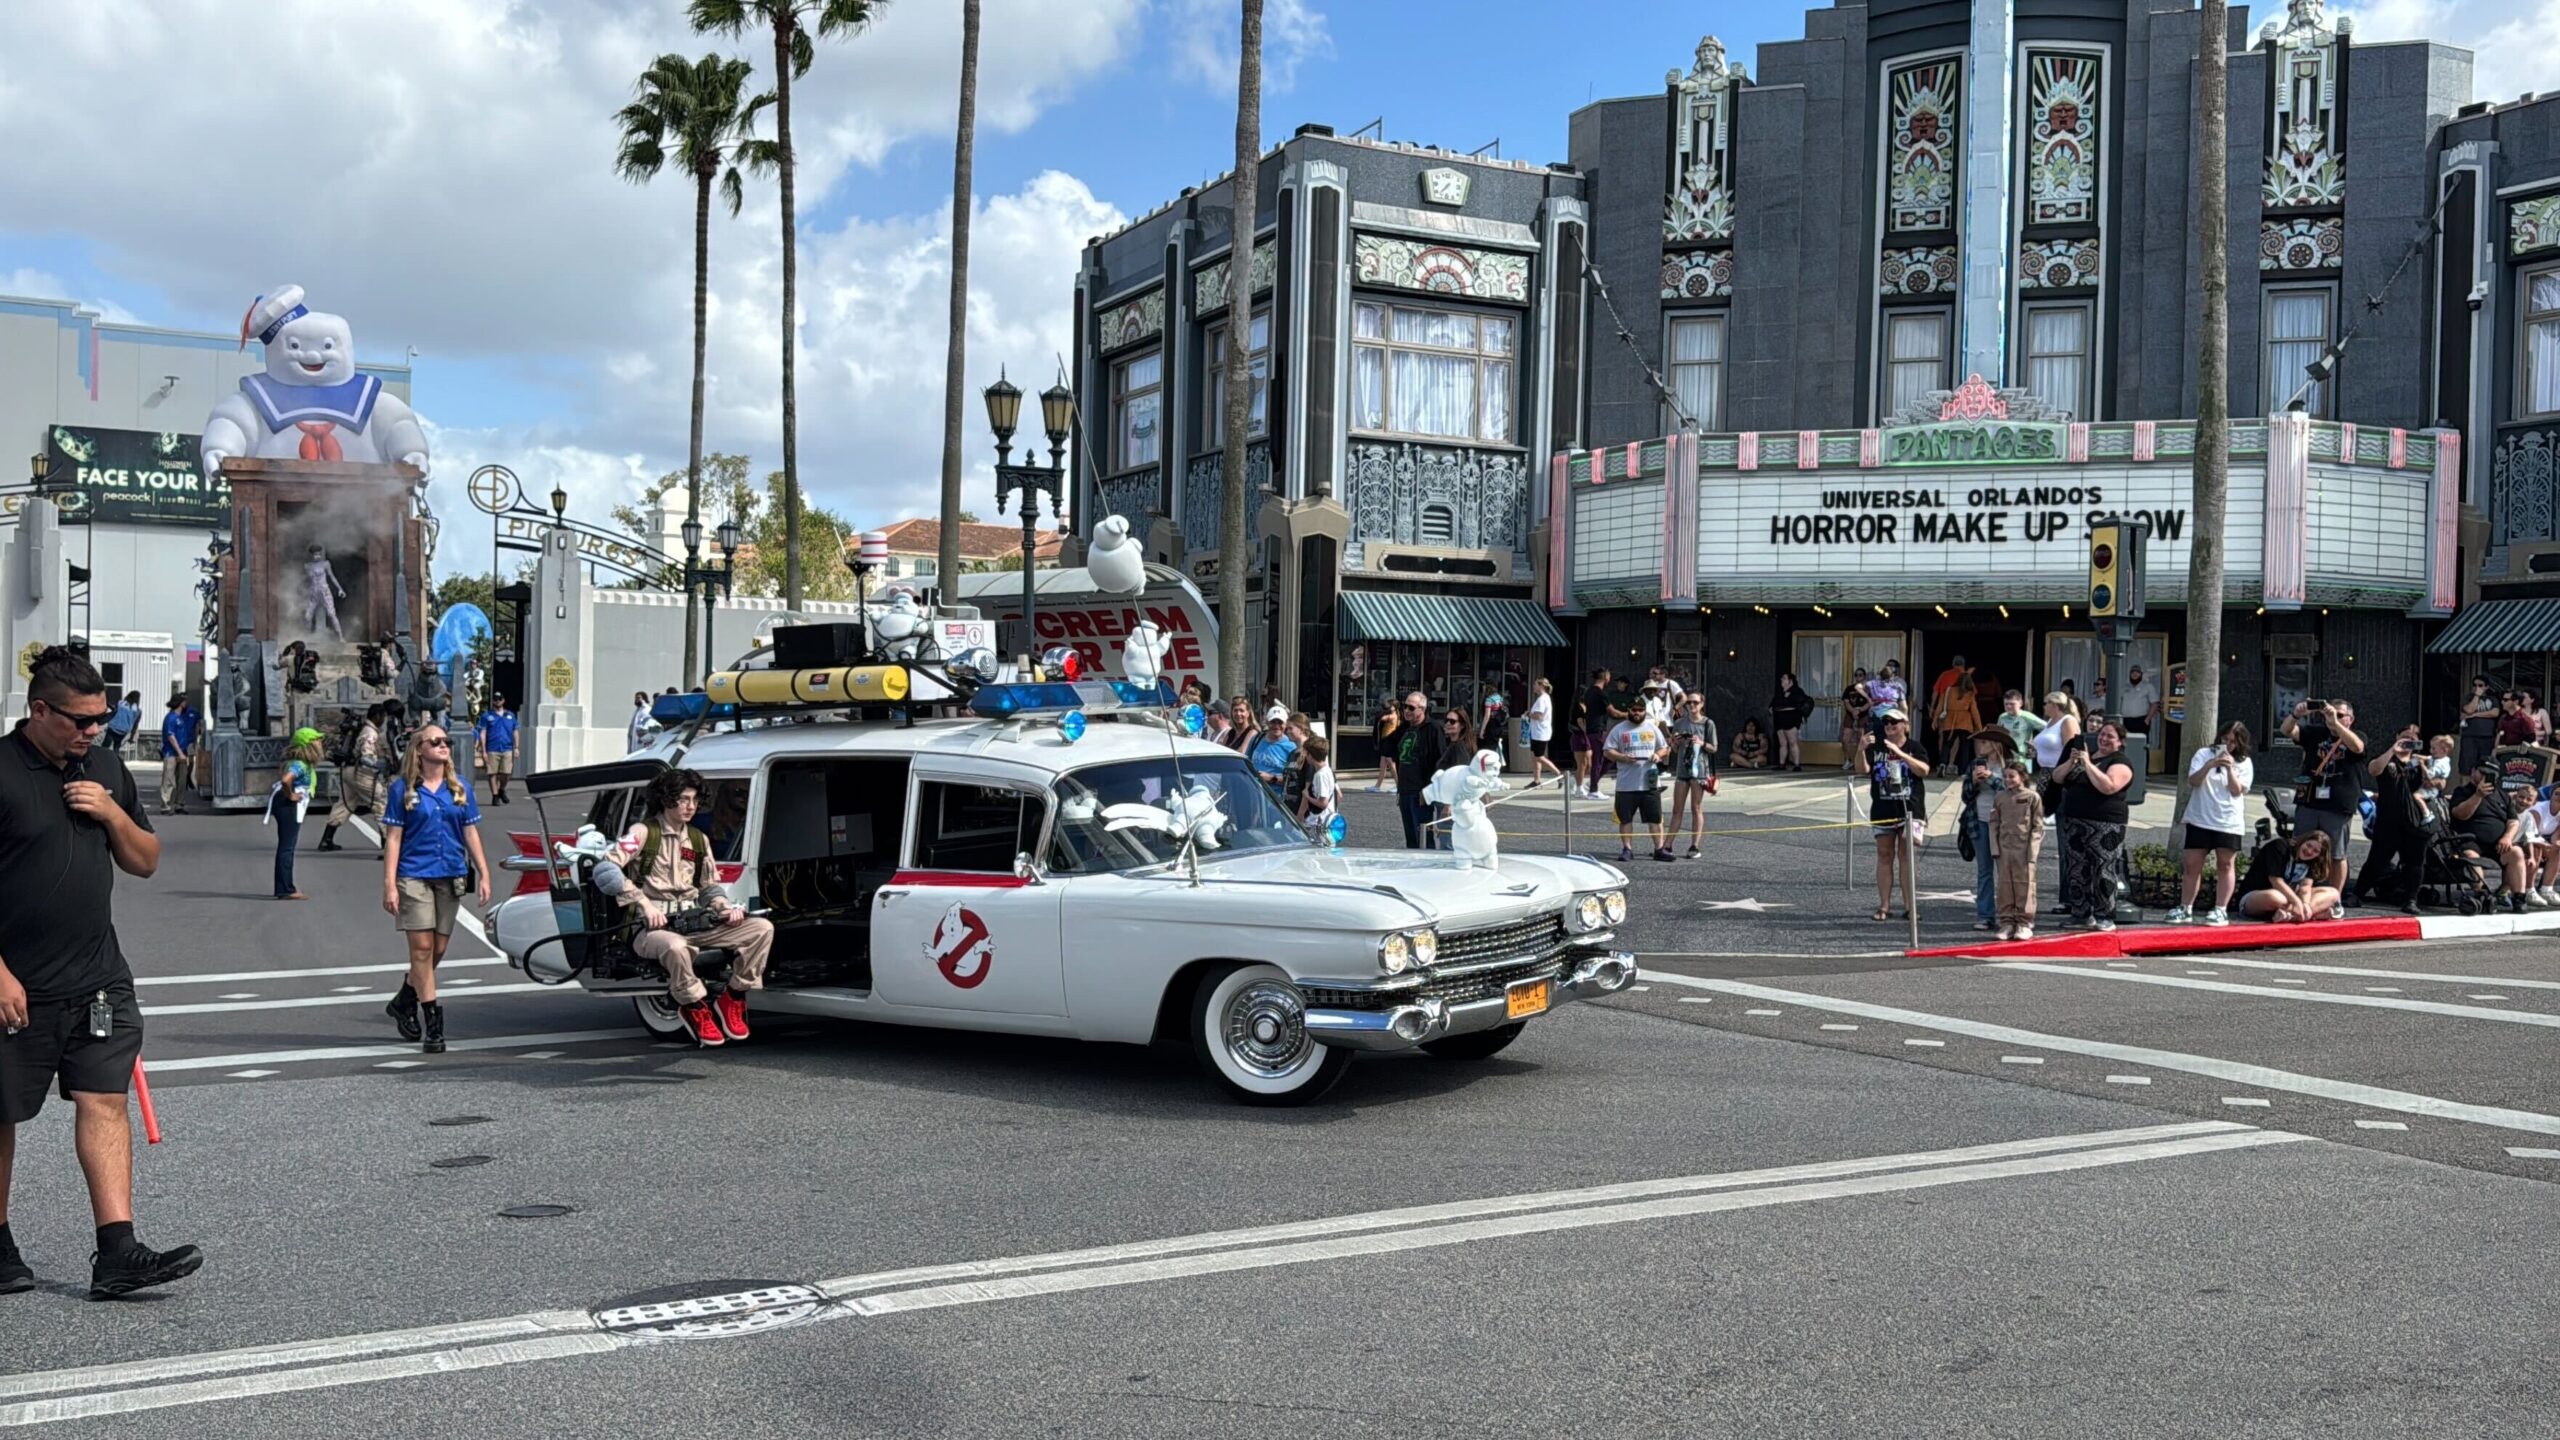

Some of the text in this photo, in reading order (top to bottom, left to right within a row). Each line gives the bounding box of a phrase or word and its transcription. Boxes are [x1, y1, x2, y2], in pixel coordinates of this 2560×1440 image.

[1892, 426, 2057, 460] PANTAGES
[77, 467, 129, 486] FACE
[135, 470, 199, 491] YOUR
[102, 491, 152, 504] peacock
[1822, 486, 2103, 509] UNIVERSAL ORLANDO'S
[1771, 514, 1897, 545] HORROR
[1913, 511, 2008, 543] MAKE
[2024, 511, 2069, 542] UP
[2505, 760, 2537, 772] HORROR
